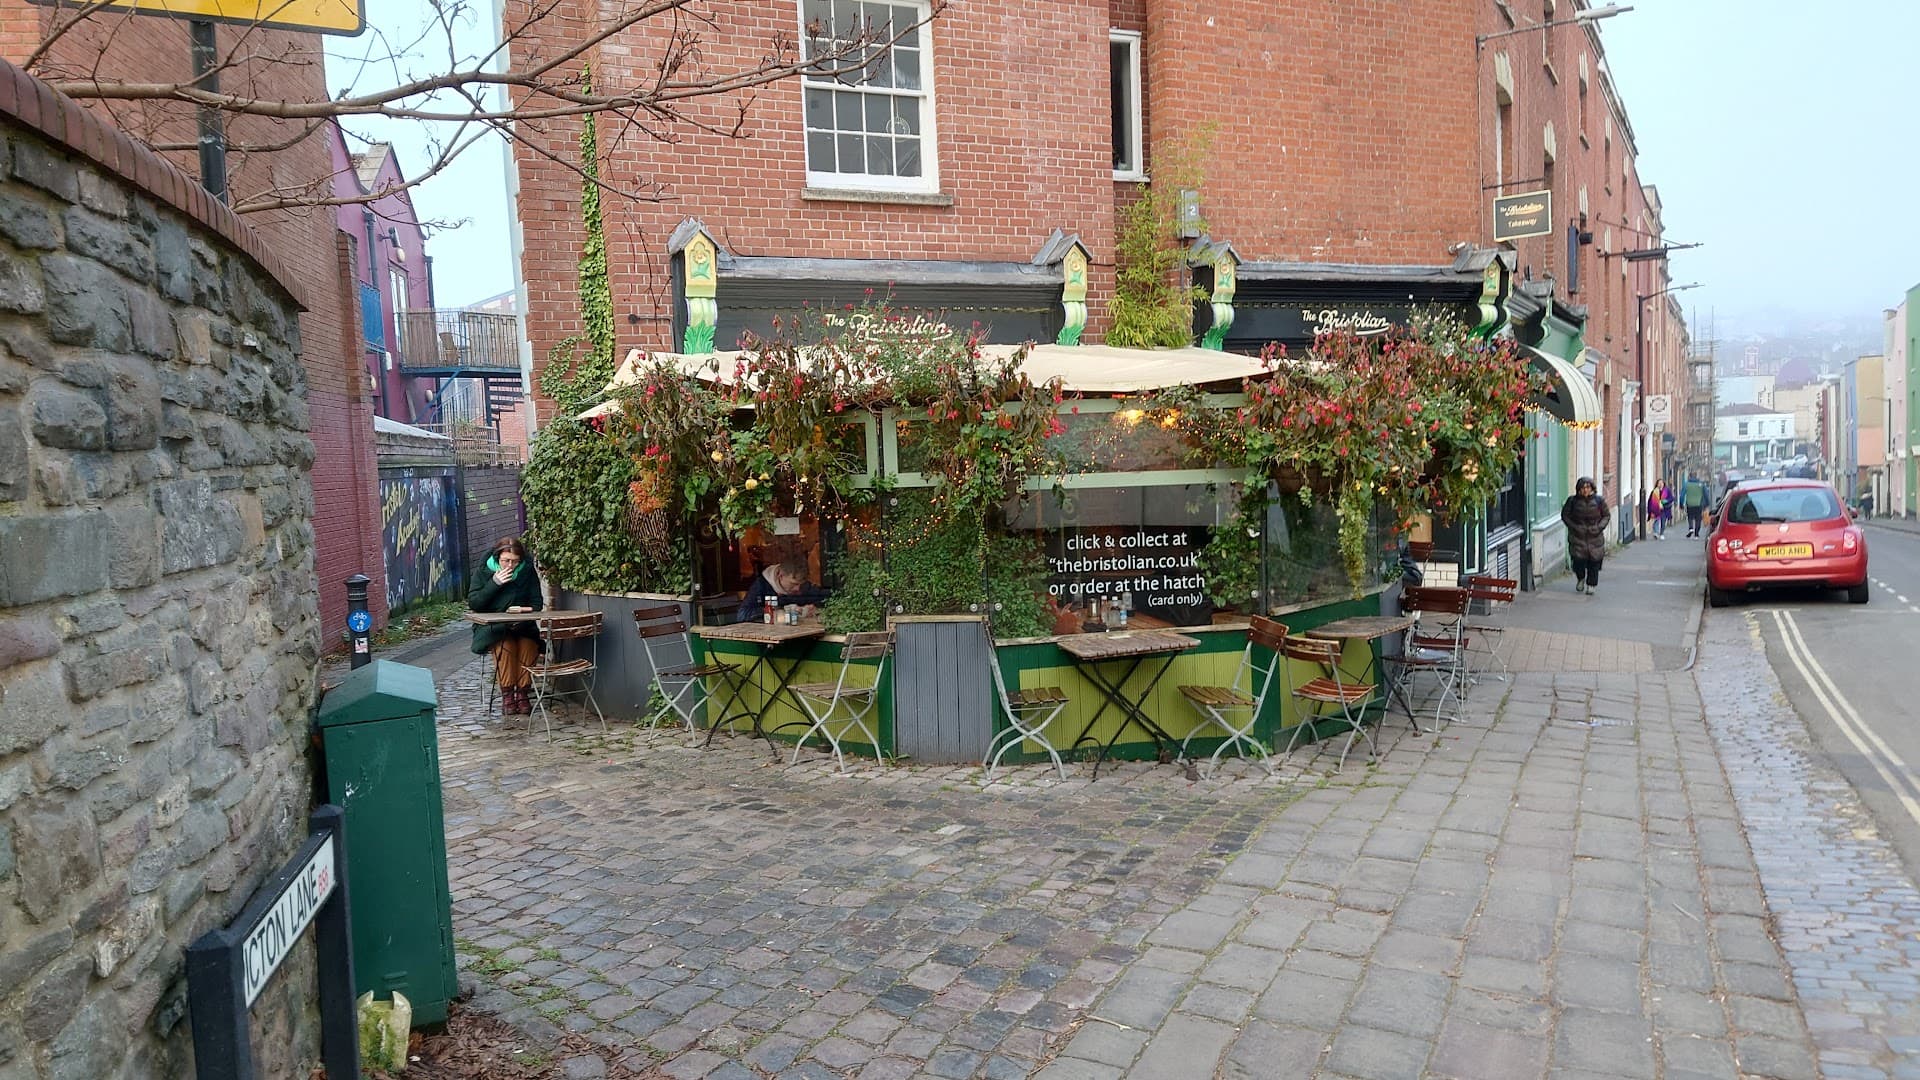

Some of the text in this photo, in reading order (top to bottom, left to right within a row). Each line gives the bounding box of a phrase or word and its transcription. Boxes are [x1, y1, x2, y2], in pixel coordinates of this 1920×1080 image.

[1190, 205, 1196, 216] 2
[824, 313, 846, 328] The
[1302, 309, 1390, 335] The Bristolian
[1066, 531, 1188, 550] click & collect at
[1049, 573, 1205, 595] or order at the hatch
[1148, 591, 1203, 607] (card only)
[244, 903, 287, 996] ICTON
[289, 862, 318, 936] LANE
